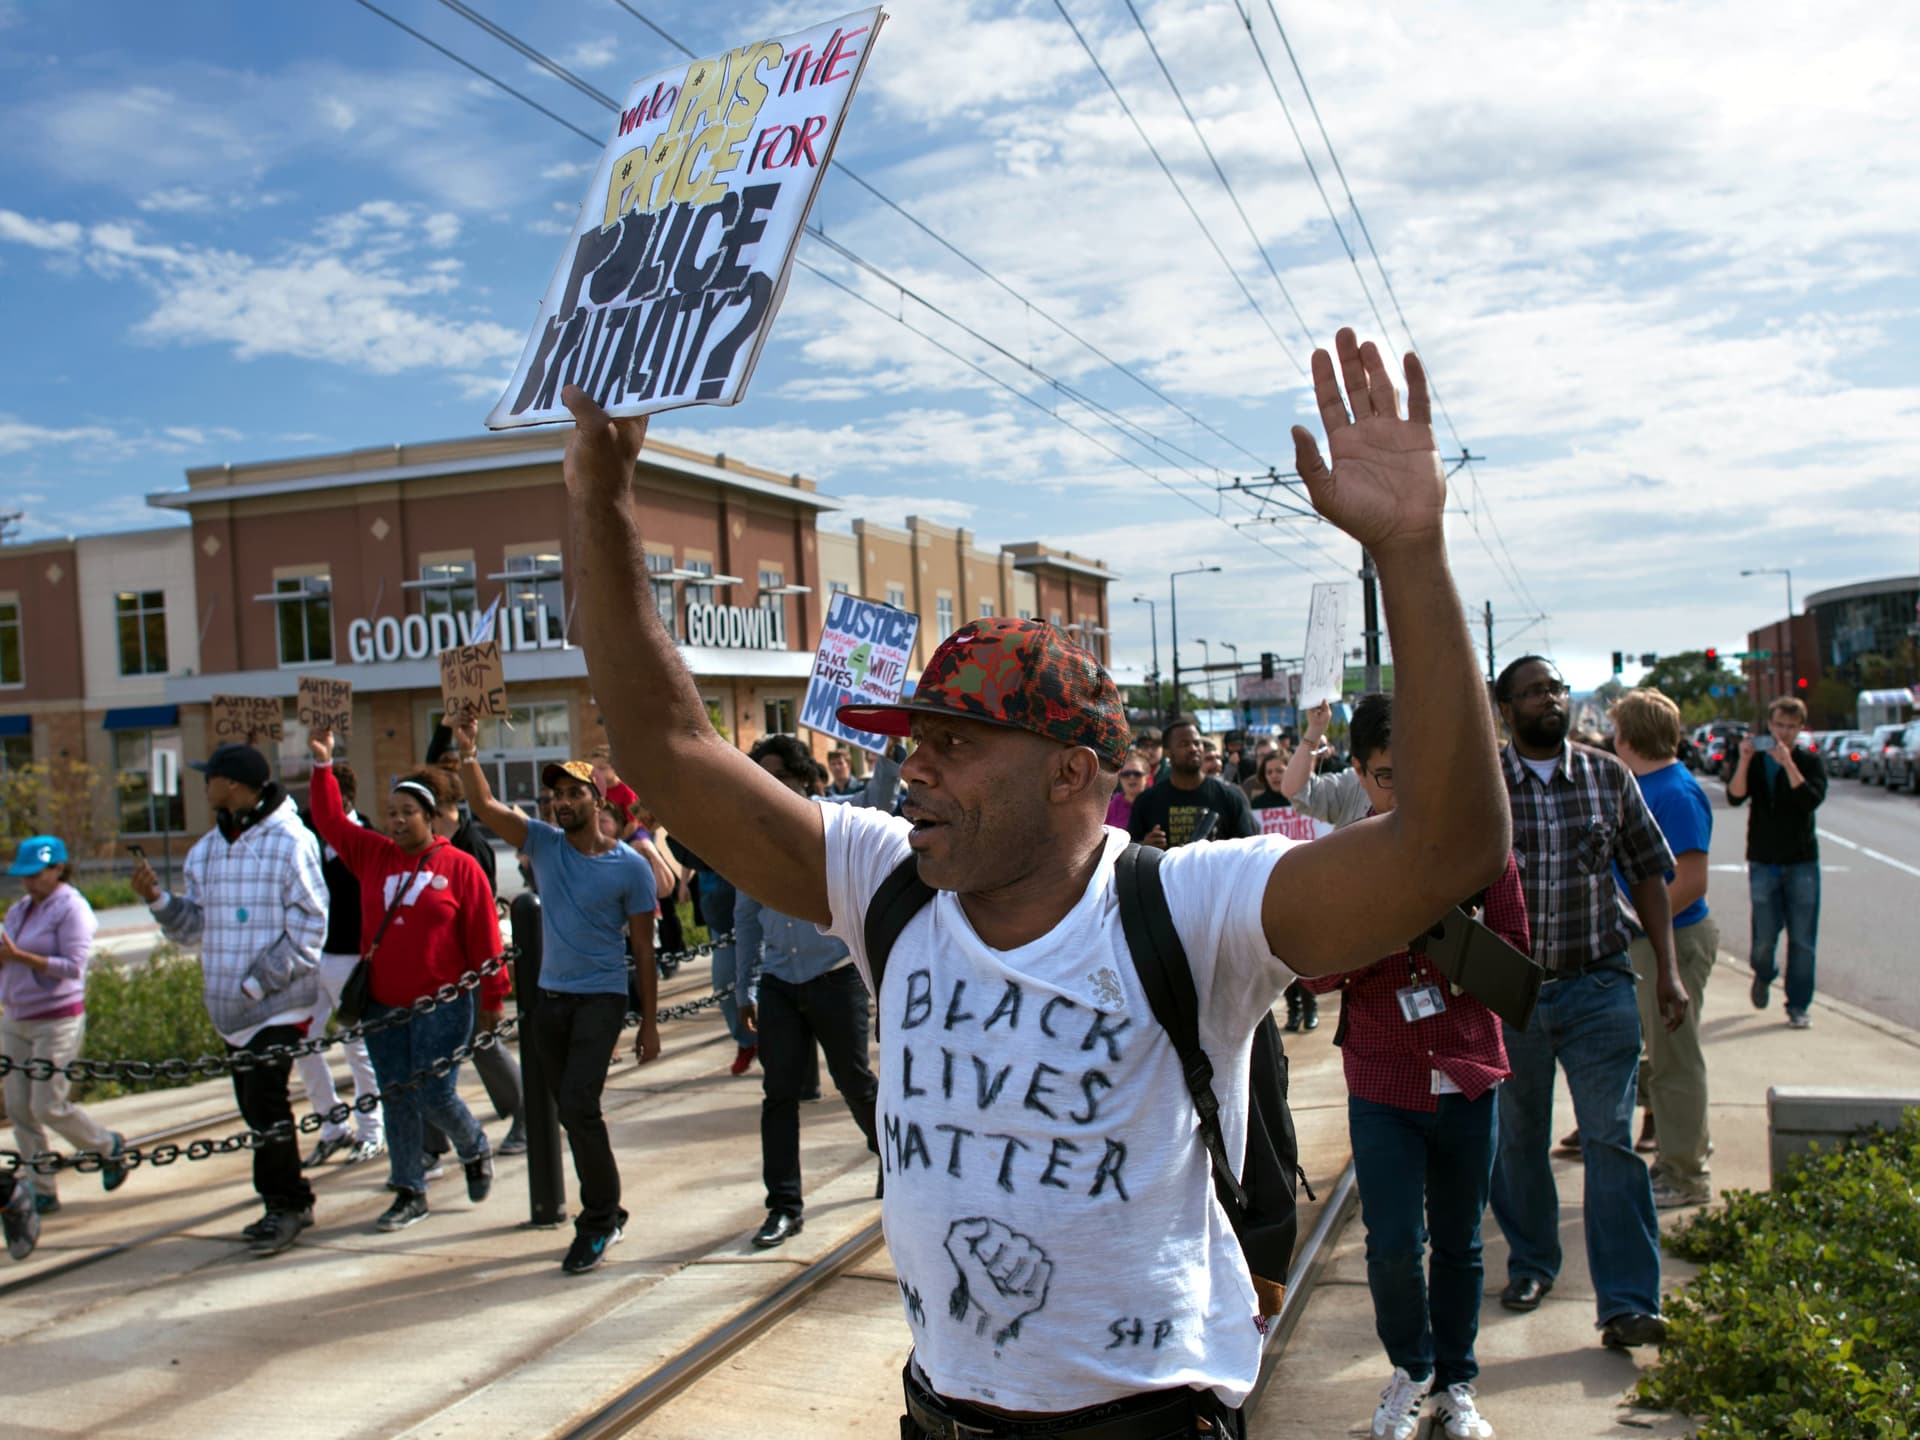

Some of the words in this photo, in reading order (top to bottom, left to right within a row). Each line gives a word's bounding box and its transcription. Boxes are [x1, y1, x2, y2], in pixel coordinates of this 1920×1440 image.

[618, 81, 680, 137] WHO
[664, 39, 784, 143] PAYS
[779, 26, 869, 97] THE
[603, 117, 755, 227] PRICE
[747, 115, 828, 175] FOR
[559, 183, 781, 325] POLICE
[348, 604, 562, 664] GOODWILL
[688, 602, 787, 650] GOODWILL
[826, 597, 917, 651] JUSTICE
[442, 643, 499, 671] AUTISM
[460, 664, 492, 688] NOT
[816, 663, 852, 688] LIVES
[819, 649, 847, 669] BLACK
[847, 643, 872, 687] 4
[300, 678, 349, 699] AUTISM
[803, 679, 888, 750] MAR
[300, 707, 349, 732] CRIME
[902, 968, 1131, 1062] BLACK
[902, 1046, 1113, 1125] LIVES
[884, 1113, 1130, 1202] MATTER
